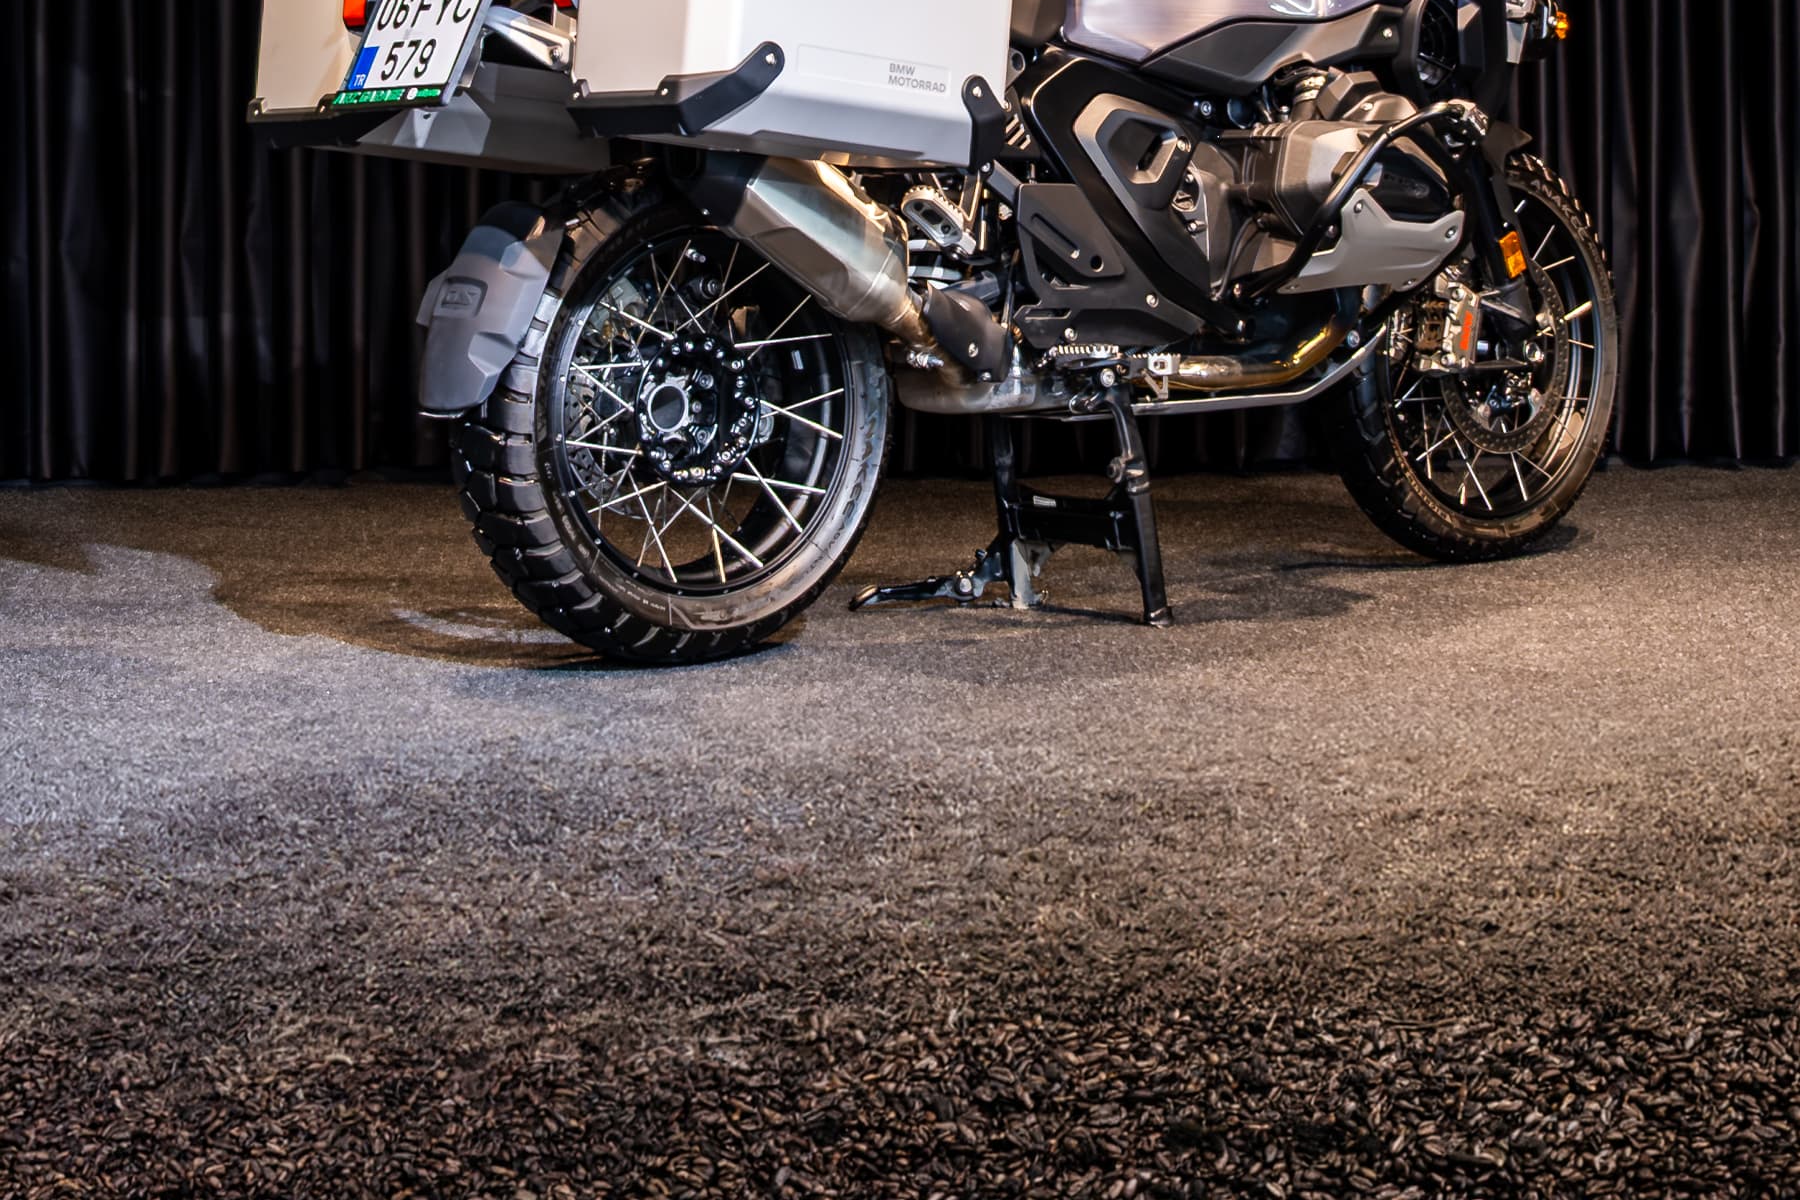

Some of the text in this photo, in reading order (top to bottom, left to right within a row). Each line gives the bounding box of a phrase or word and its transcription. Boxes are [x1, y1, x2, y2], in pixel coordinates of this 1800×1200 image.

[381, 39, 437, 81] 579
[889, 63, 916, 76] BMW
[353, 74, 366, 87] TR
[888, 75, 946, 93] MOTORRAD
